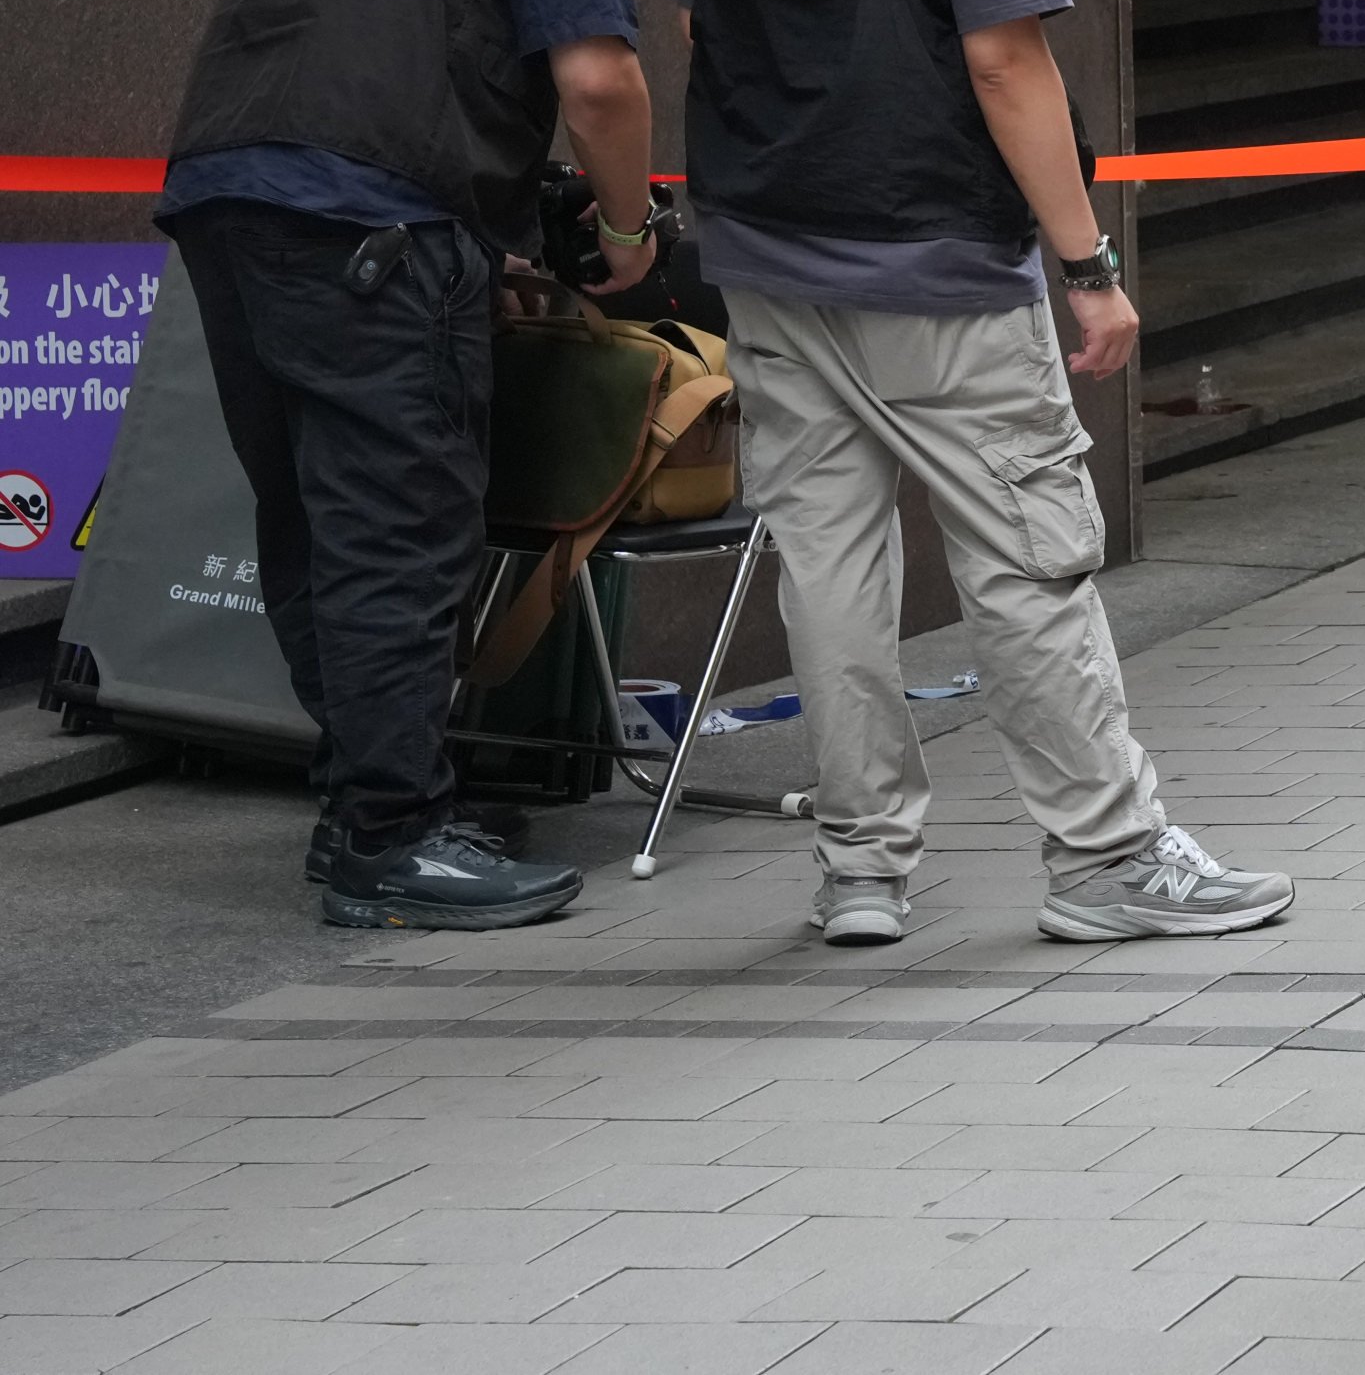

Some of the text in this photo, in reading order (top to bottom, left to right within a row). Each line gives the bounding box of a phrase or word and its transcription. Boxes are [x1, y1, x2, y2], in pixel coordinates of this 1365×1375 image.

[0, 330, 144, 365] on the stai
[169, 583, 222, 608] Grand
